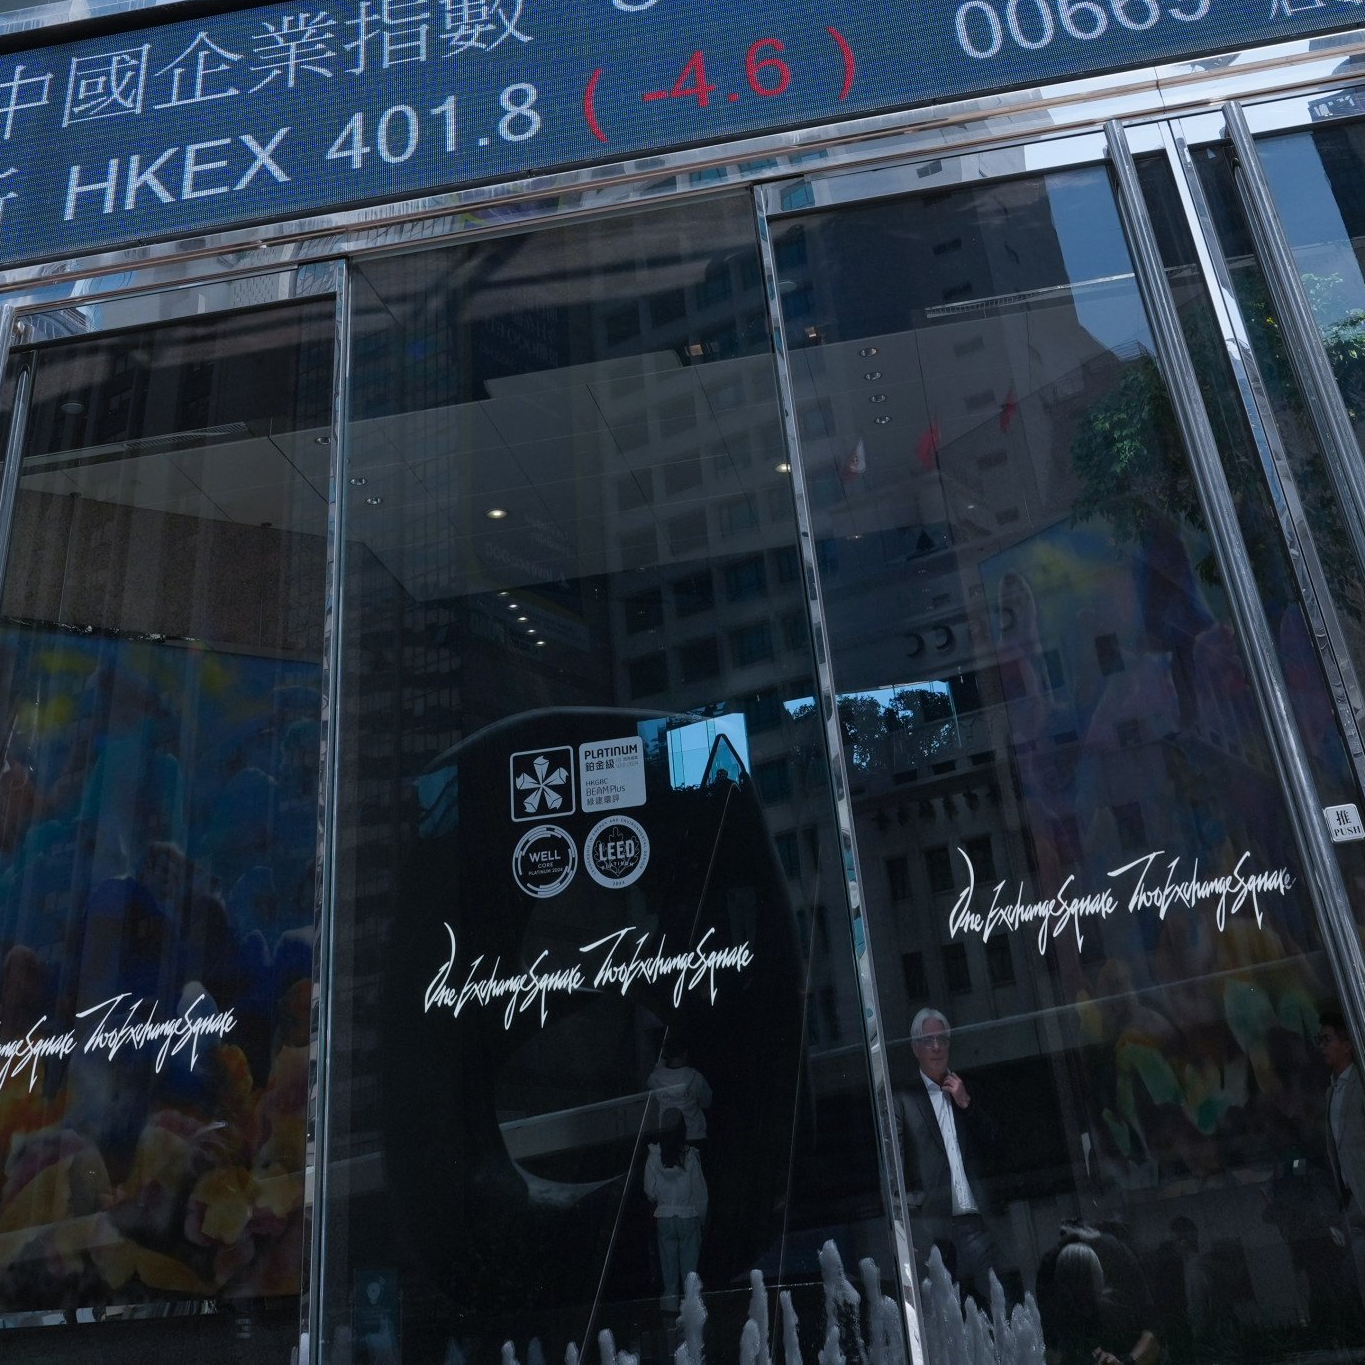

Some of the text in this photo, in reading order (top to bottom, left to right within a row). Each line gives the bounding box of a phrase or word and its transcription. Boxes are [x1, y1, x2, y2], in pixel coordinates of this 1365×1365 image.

[63, 125, 293, 221] HKEX
[325, 82, 542, 171] 401.8
[584, 744, 638, 760] PLATINUM
[610, 785, 626, 793] Plus
[1336, 810, 1352, 825] 推
[1334, 825, 1361, 837] PUSH
[529, 849, 561, 863] WELL
[598, 839, 635, 861] LEED
